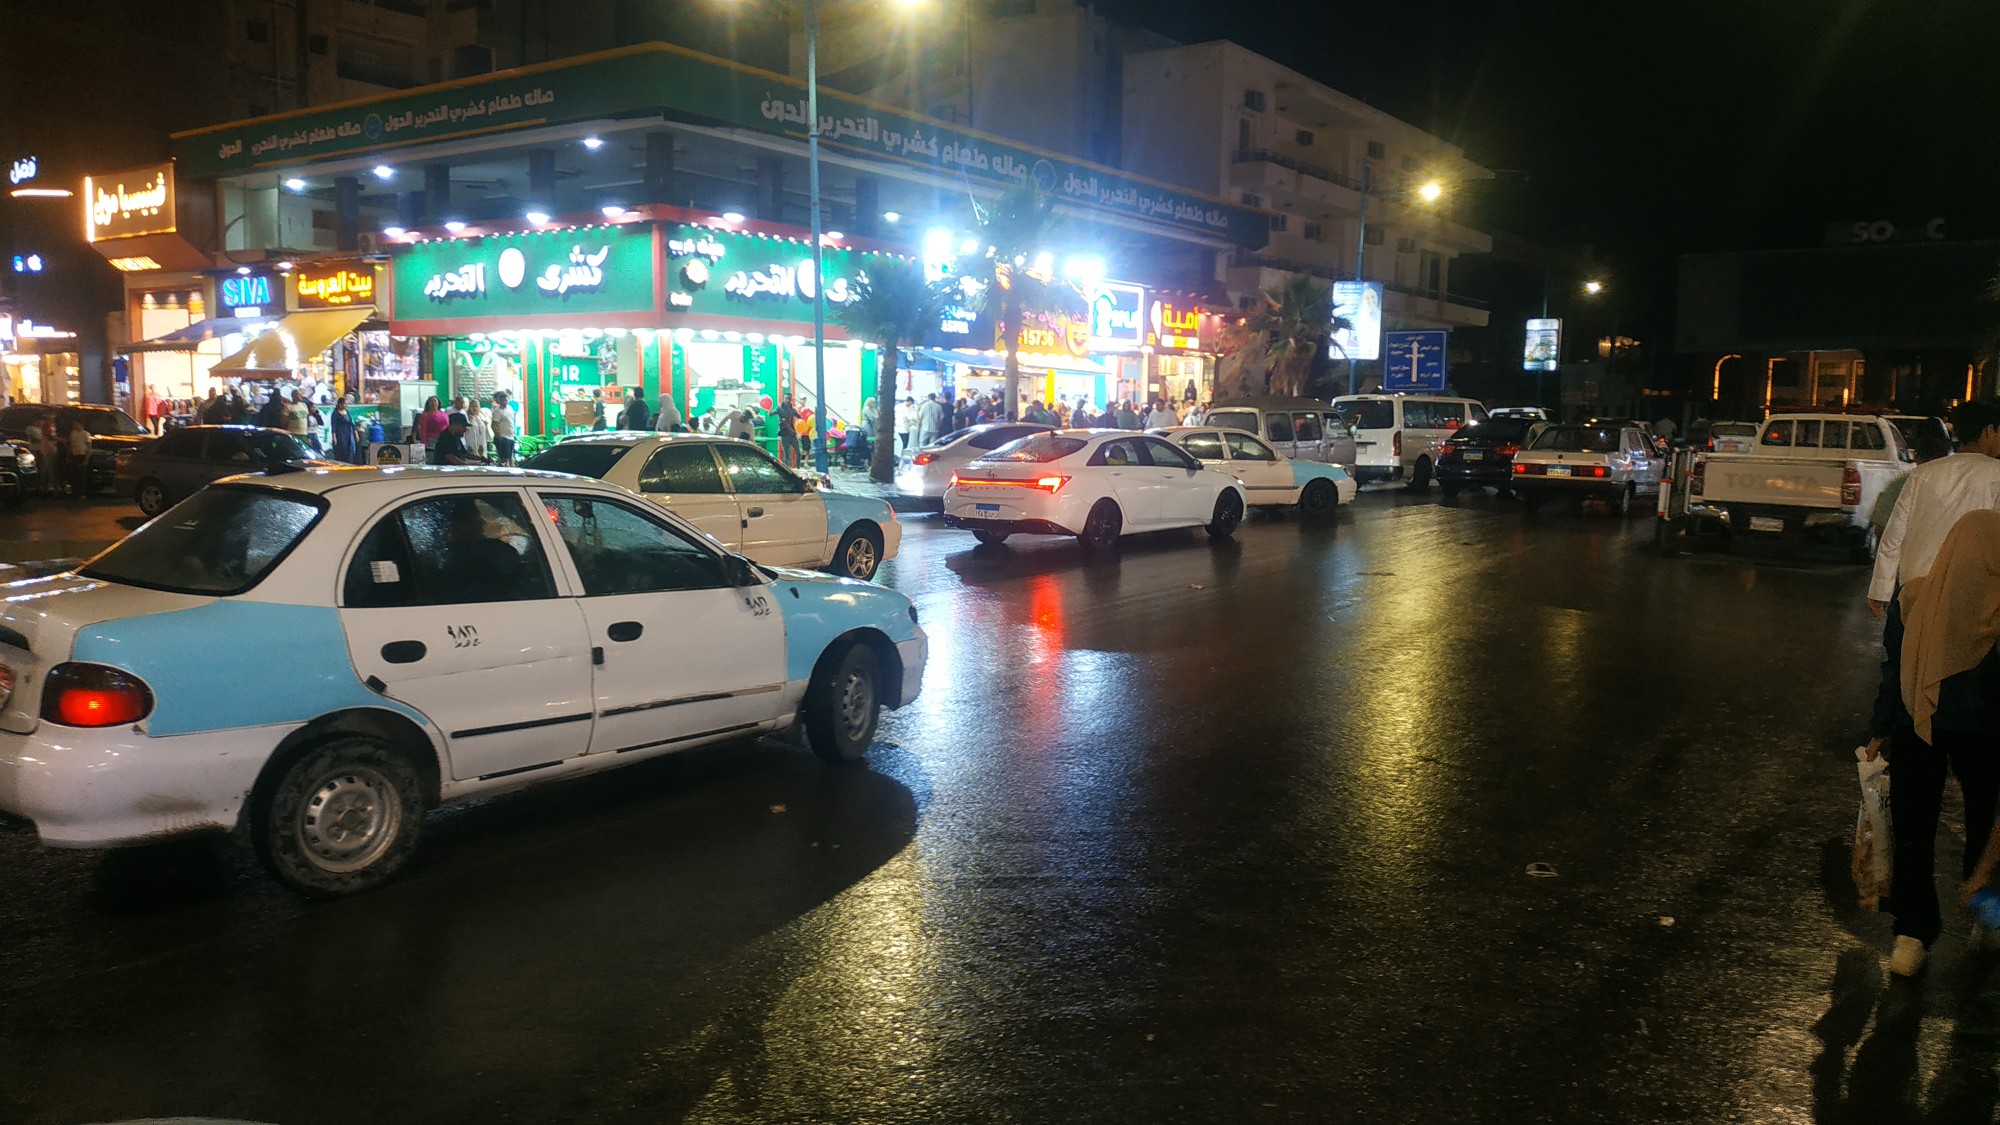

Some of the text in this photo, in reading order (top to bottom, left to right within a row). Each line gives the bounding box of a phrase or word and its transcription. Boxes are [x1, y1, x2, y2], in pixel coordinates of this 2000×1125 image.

[298, 270, 372, 300] بيت العروسة
[424, 262, 485, 298] التحرير
[725, 264, 796, 298] التحرير
[1724, 472, 1818, 490] TOYOTA
